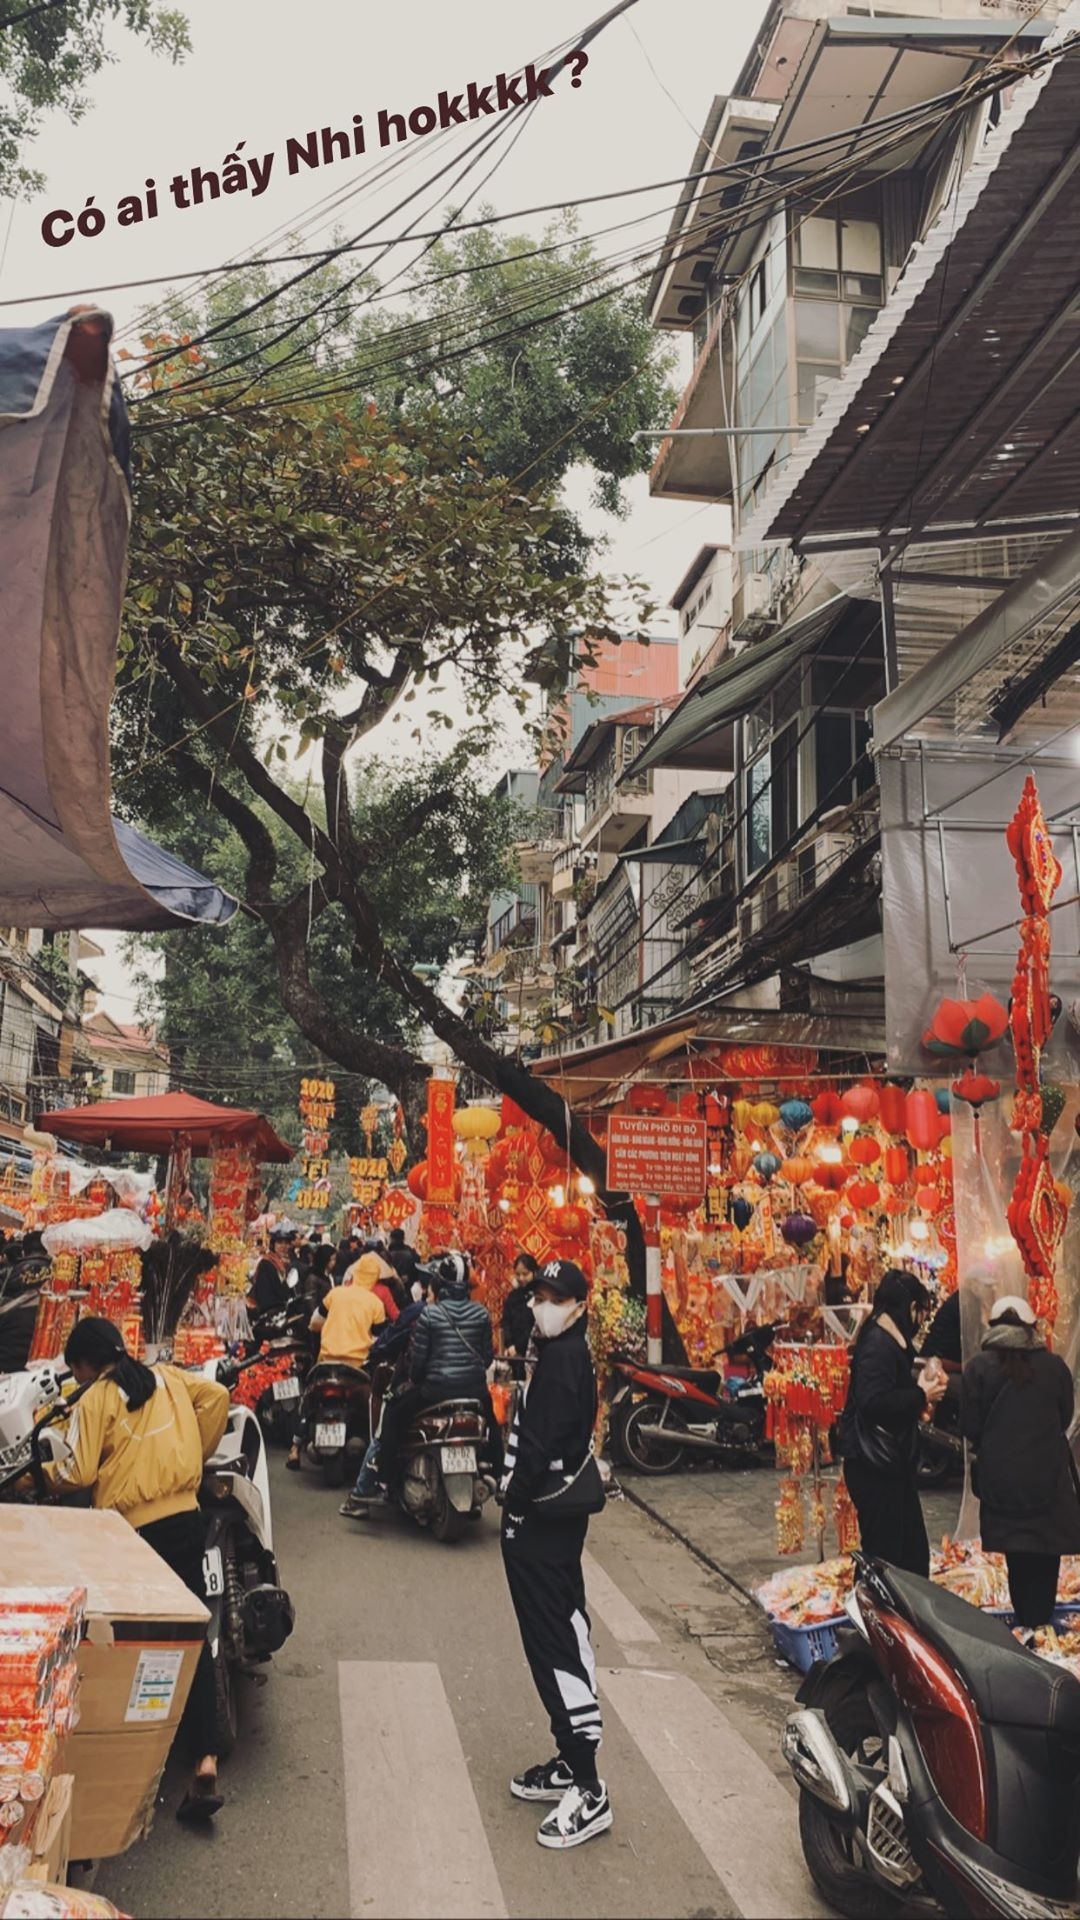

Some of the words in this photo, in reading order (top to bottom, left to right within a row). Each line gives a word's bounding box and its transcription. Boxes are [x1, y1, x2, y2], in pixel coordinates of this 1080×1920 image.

[619, 1120, 649, 1131] TUYẾN
[650, 1121, 671, 1133] PHỐ
[672, 1124, 682, 1133] ĐI
[683, 1123, 697, 1135] BỘ
